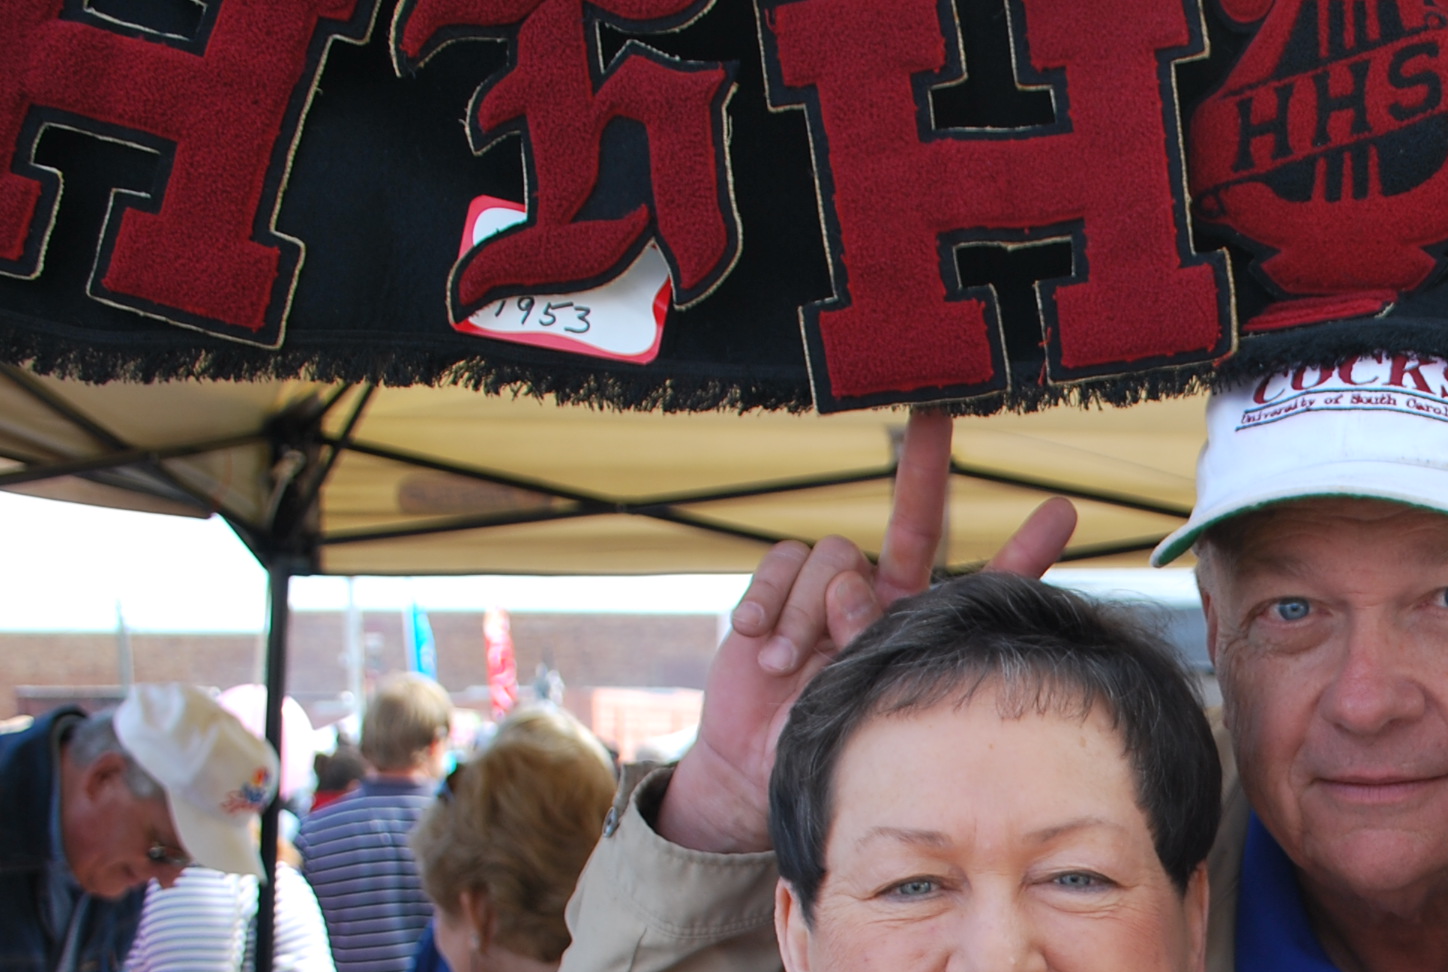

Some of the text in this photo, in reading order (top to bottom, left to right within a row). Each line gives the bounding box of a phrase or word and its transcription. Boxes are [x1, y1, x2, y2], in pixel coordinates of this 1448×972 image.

[1231, 41, 1442, 172] HHS
[762, 0, 1222, 397] H
[494, 296, 592, 334] 1953
[1241, 396, 1315, 424] University
[1324, 394, 1344, 405] of
[1350, 394, 1397, 406] South
